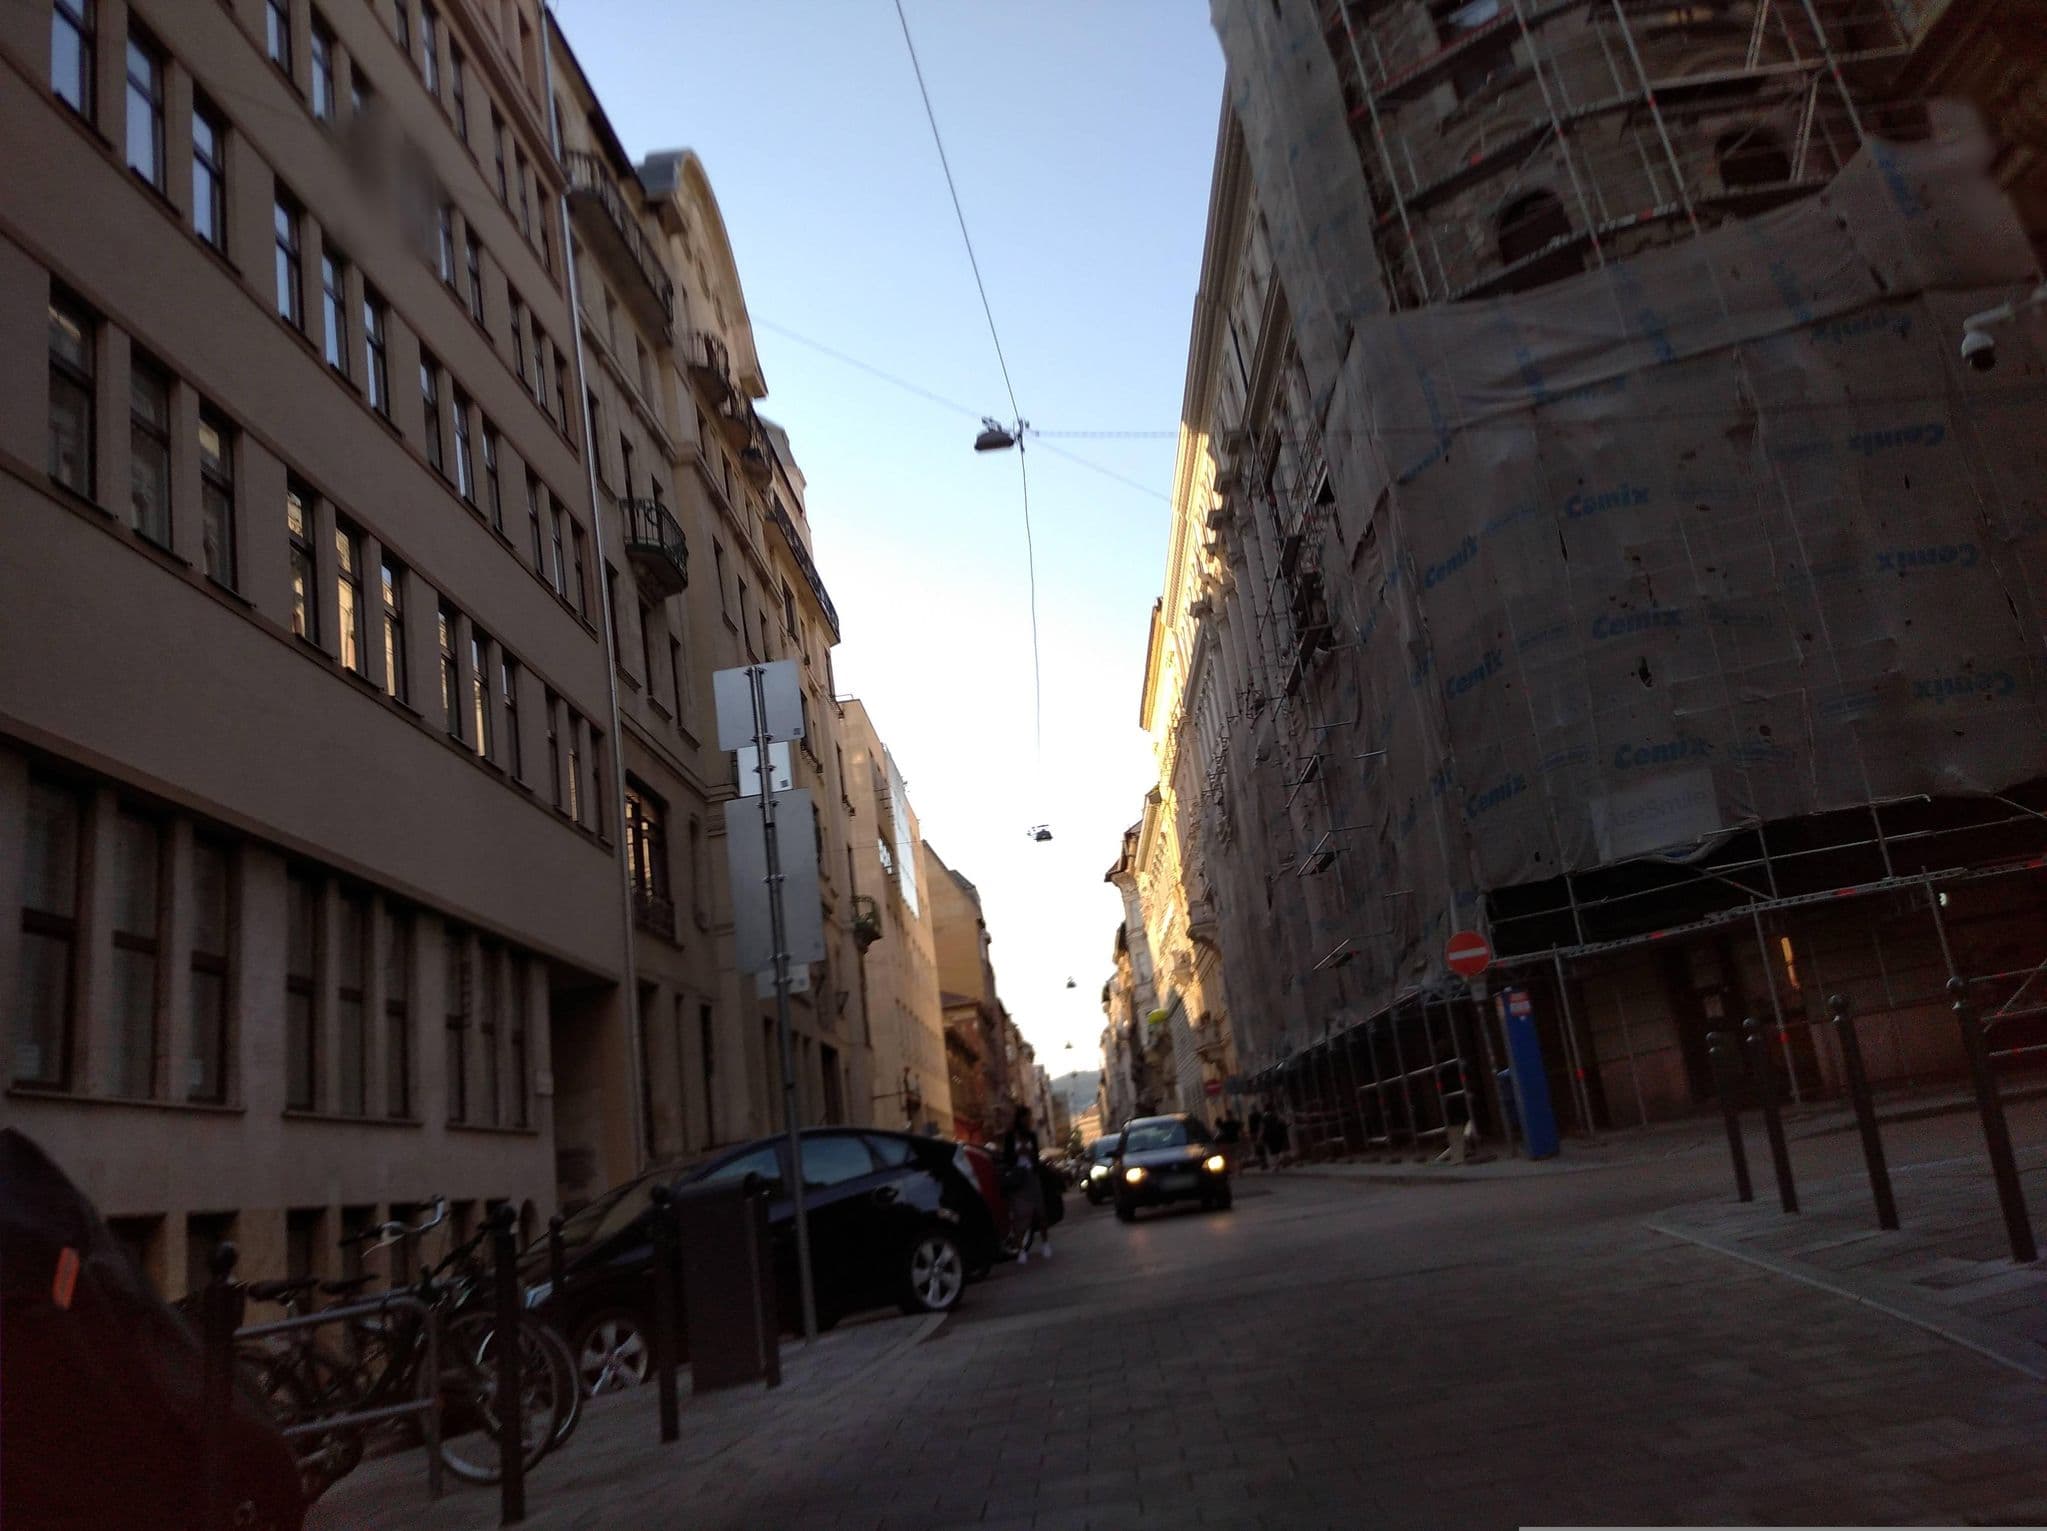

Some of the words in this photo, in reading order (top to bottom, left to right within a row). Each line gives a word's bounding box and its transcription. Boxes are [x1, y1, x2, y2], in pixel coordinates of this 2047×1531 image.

[1564, 483, 1650, 519] Comix
[1423, 534, 1479, 589] Comix
[1592, 607, 1682, 641] Comix
[1446, 649, 1502, 699] Comix
[1613, 732, 1708, 771] Comix
[1465, 773, 1526, 820] Comix
